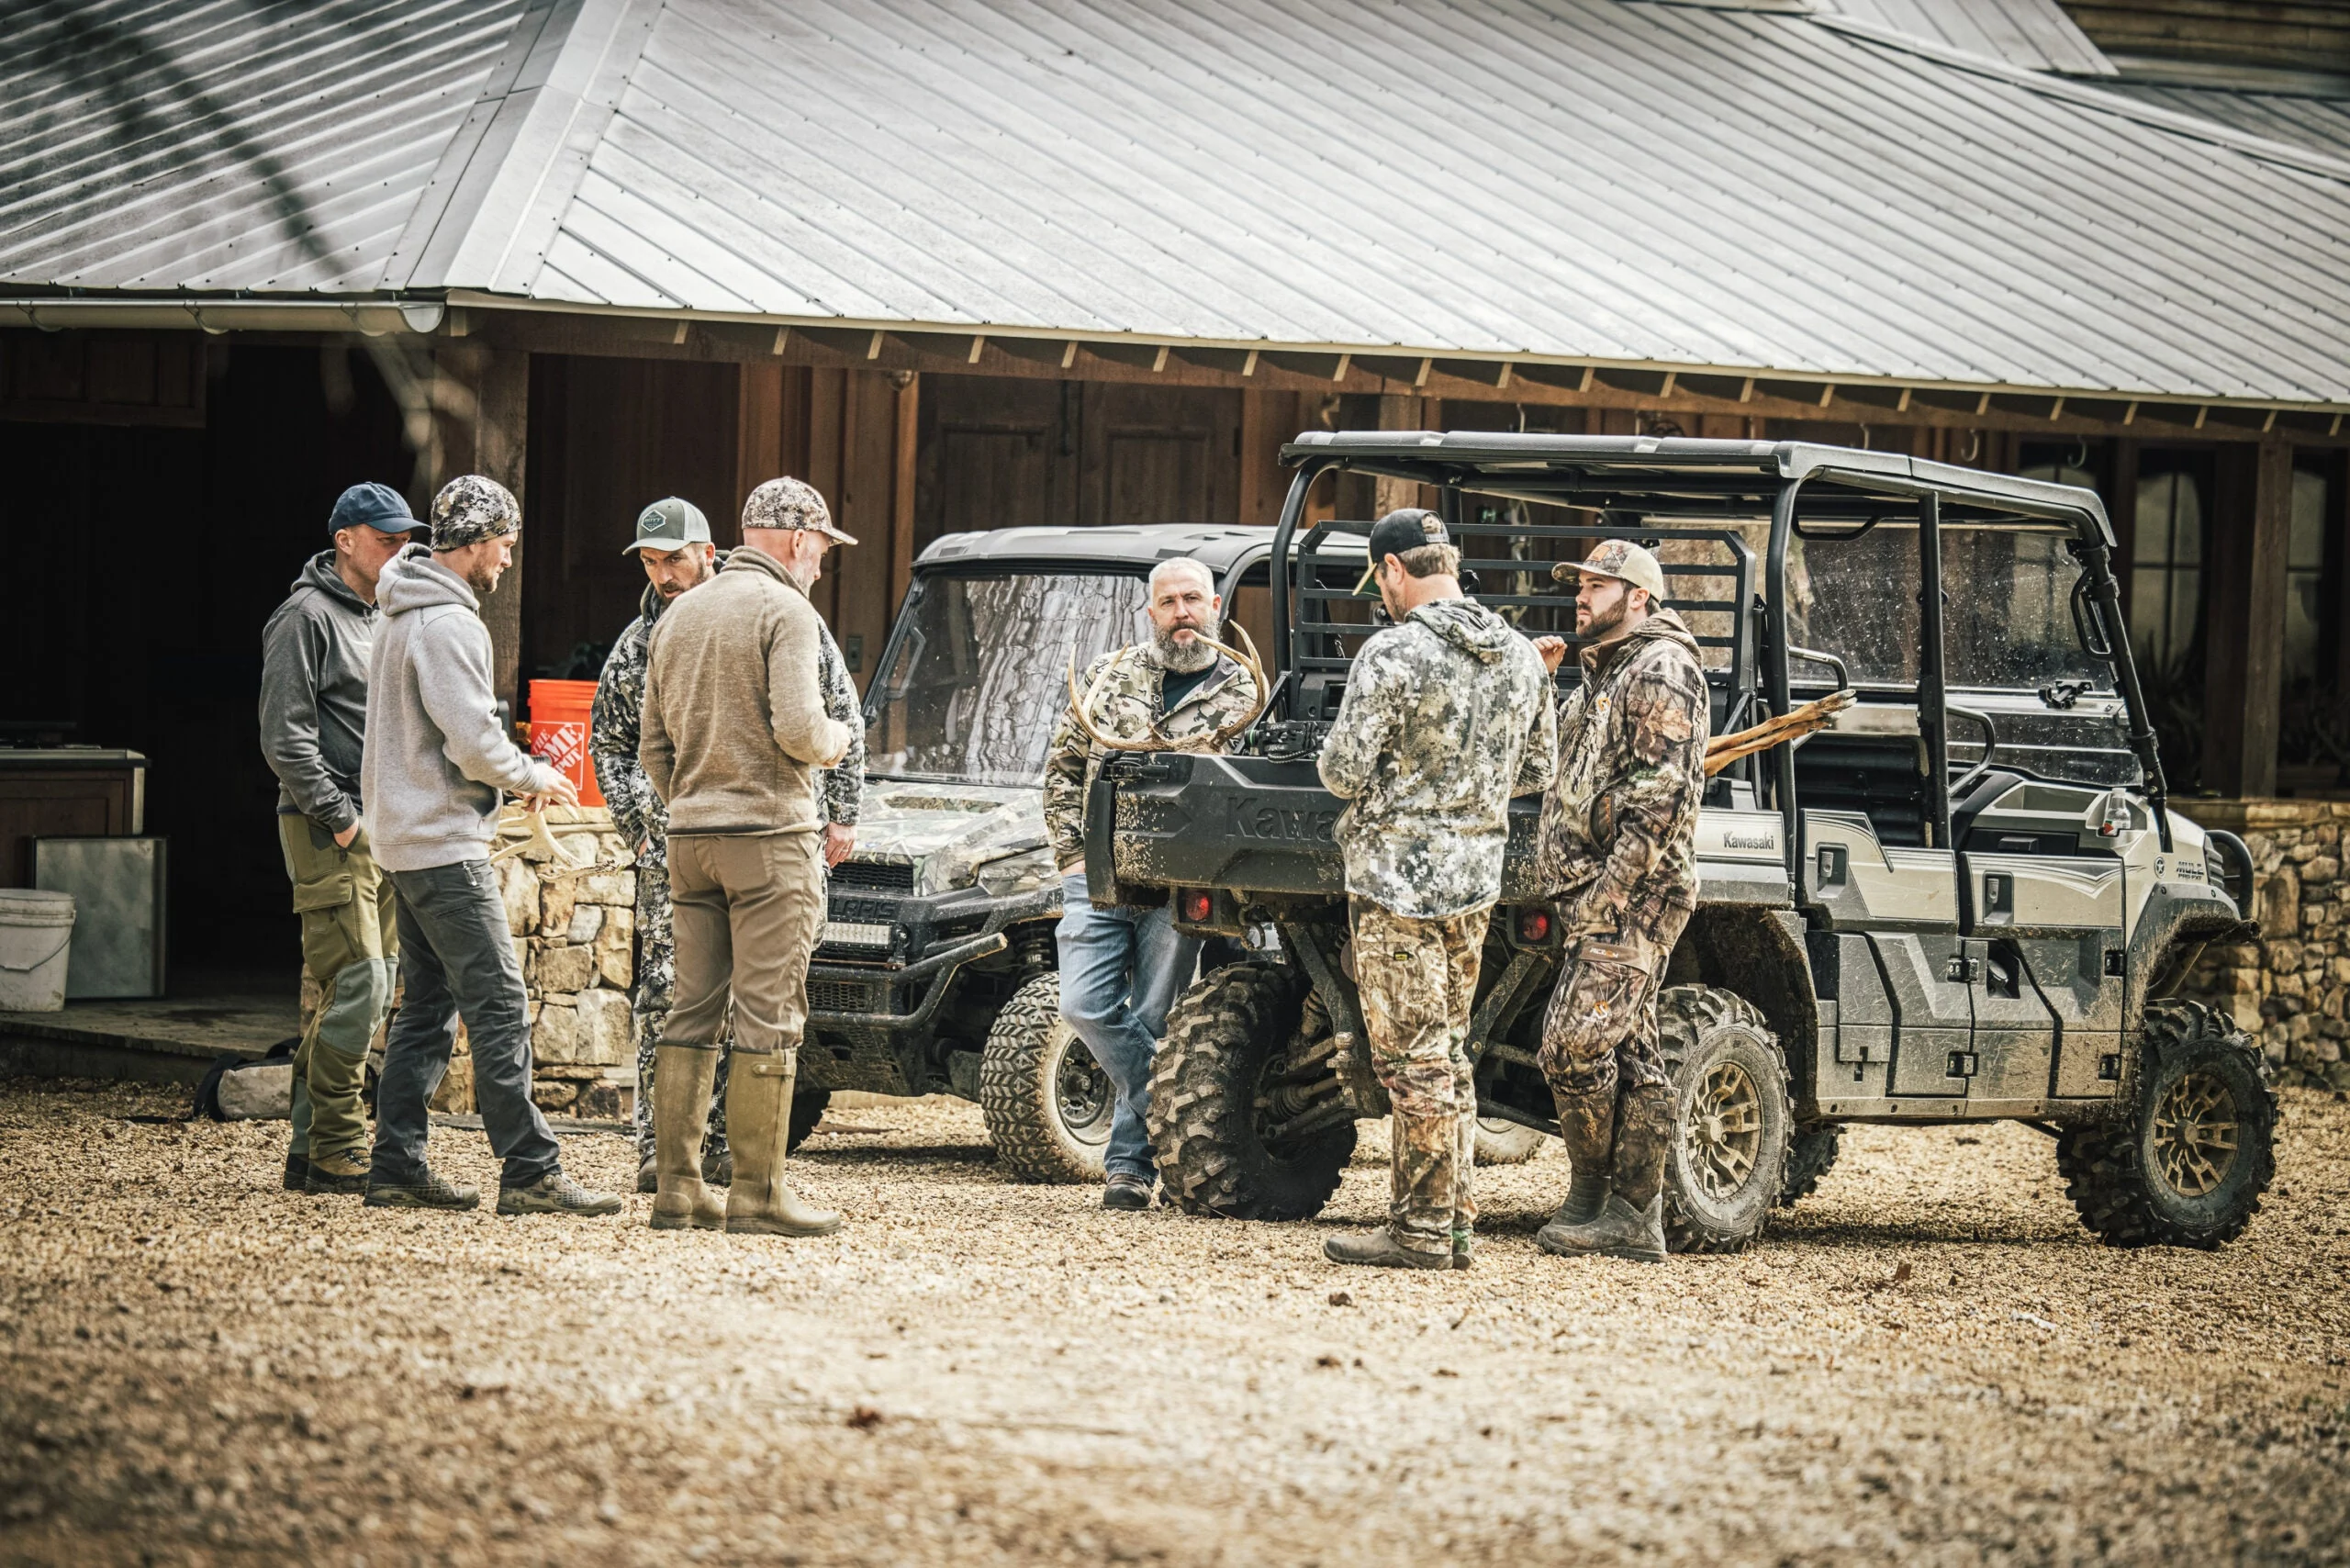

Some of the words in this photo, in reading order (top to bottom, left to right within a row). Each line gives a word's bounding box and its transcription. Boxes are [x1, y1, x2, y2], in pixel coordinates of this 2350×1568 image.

[532, 729, 551, 753] THE
[554, 747, 582, 774] POT
[1225, 796, 1336, 842] Kawa
[1723, 831, 1774, 850] Kawasaki
[2177, 861, 2204, 875] MULE
[827, 899, 897, 921] LARIS
